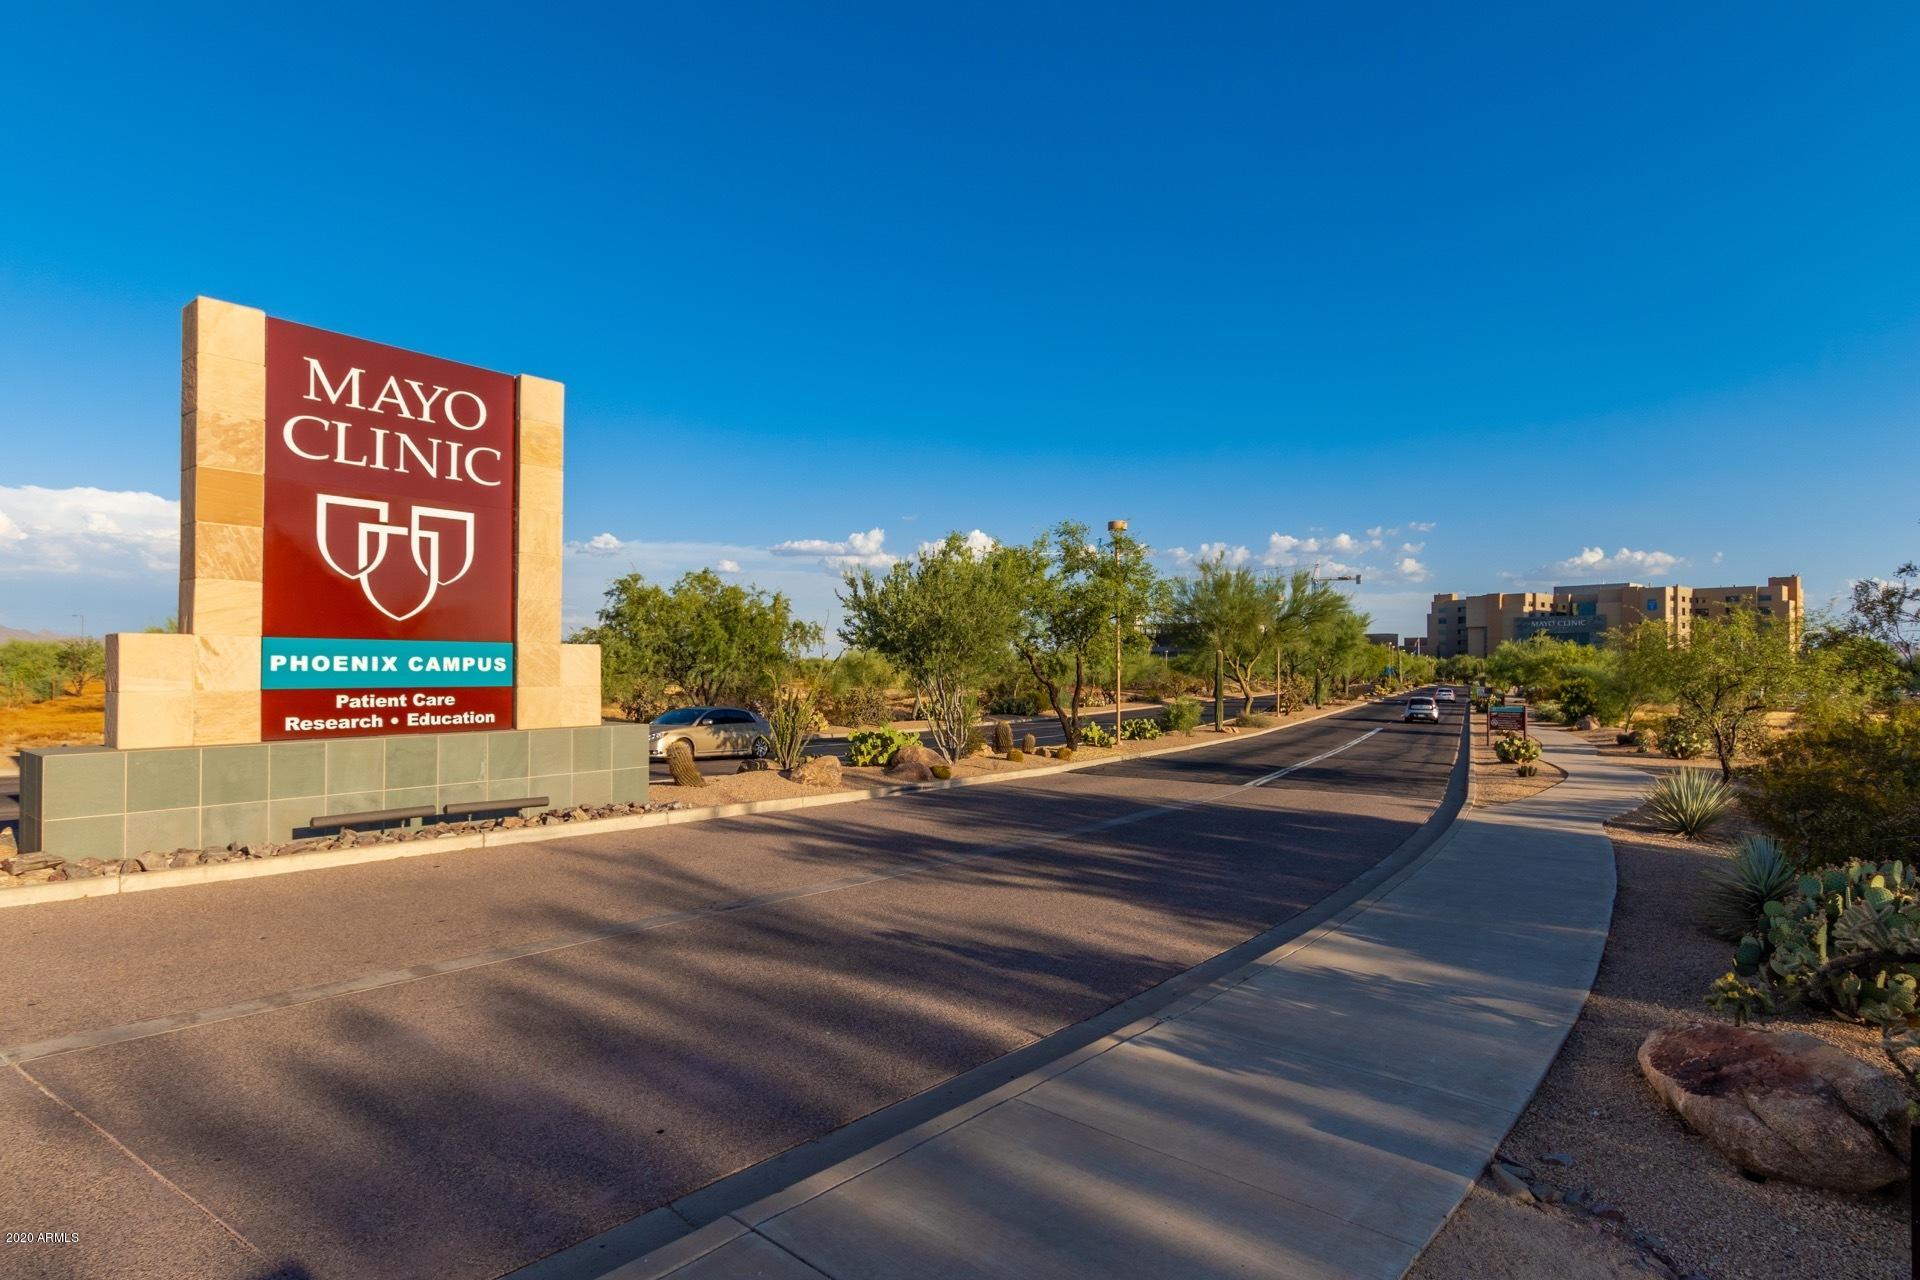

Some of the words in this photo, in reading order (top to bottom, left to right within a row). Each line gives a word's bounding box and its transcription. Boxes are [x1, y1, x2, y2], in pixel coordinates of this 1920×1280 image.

[303, 356, 487, 431] MAYO
[282, 415, 501, 486] CLINIC
[1557, 619, 1586, 627] CLINIC
[269, 655, 399, 672] PHOENIX
[407, 656, 508, 672] CAMPUS
[335, 693, 408, 709] Patient
[412, 693, 456, 706] Care
[284, 714, 384, 731] Research
[406, 711, 496, 726] Education
